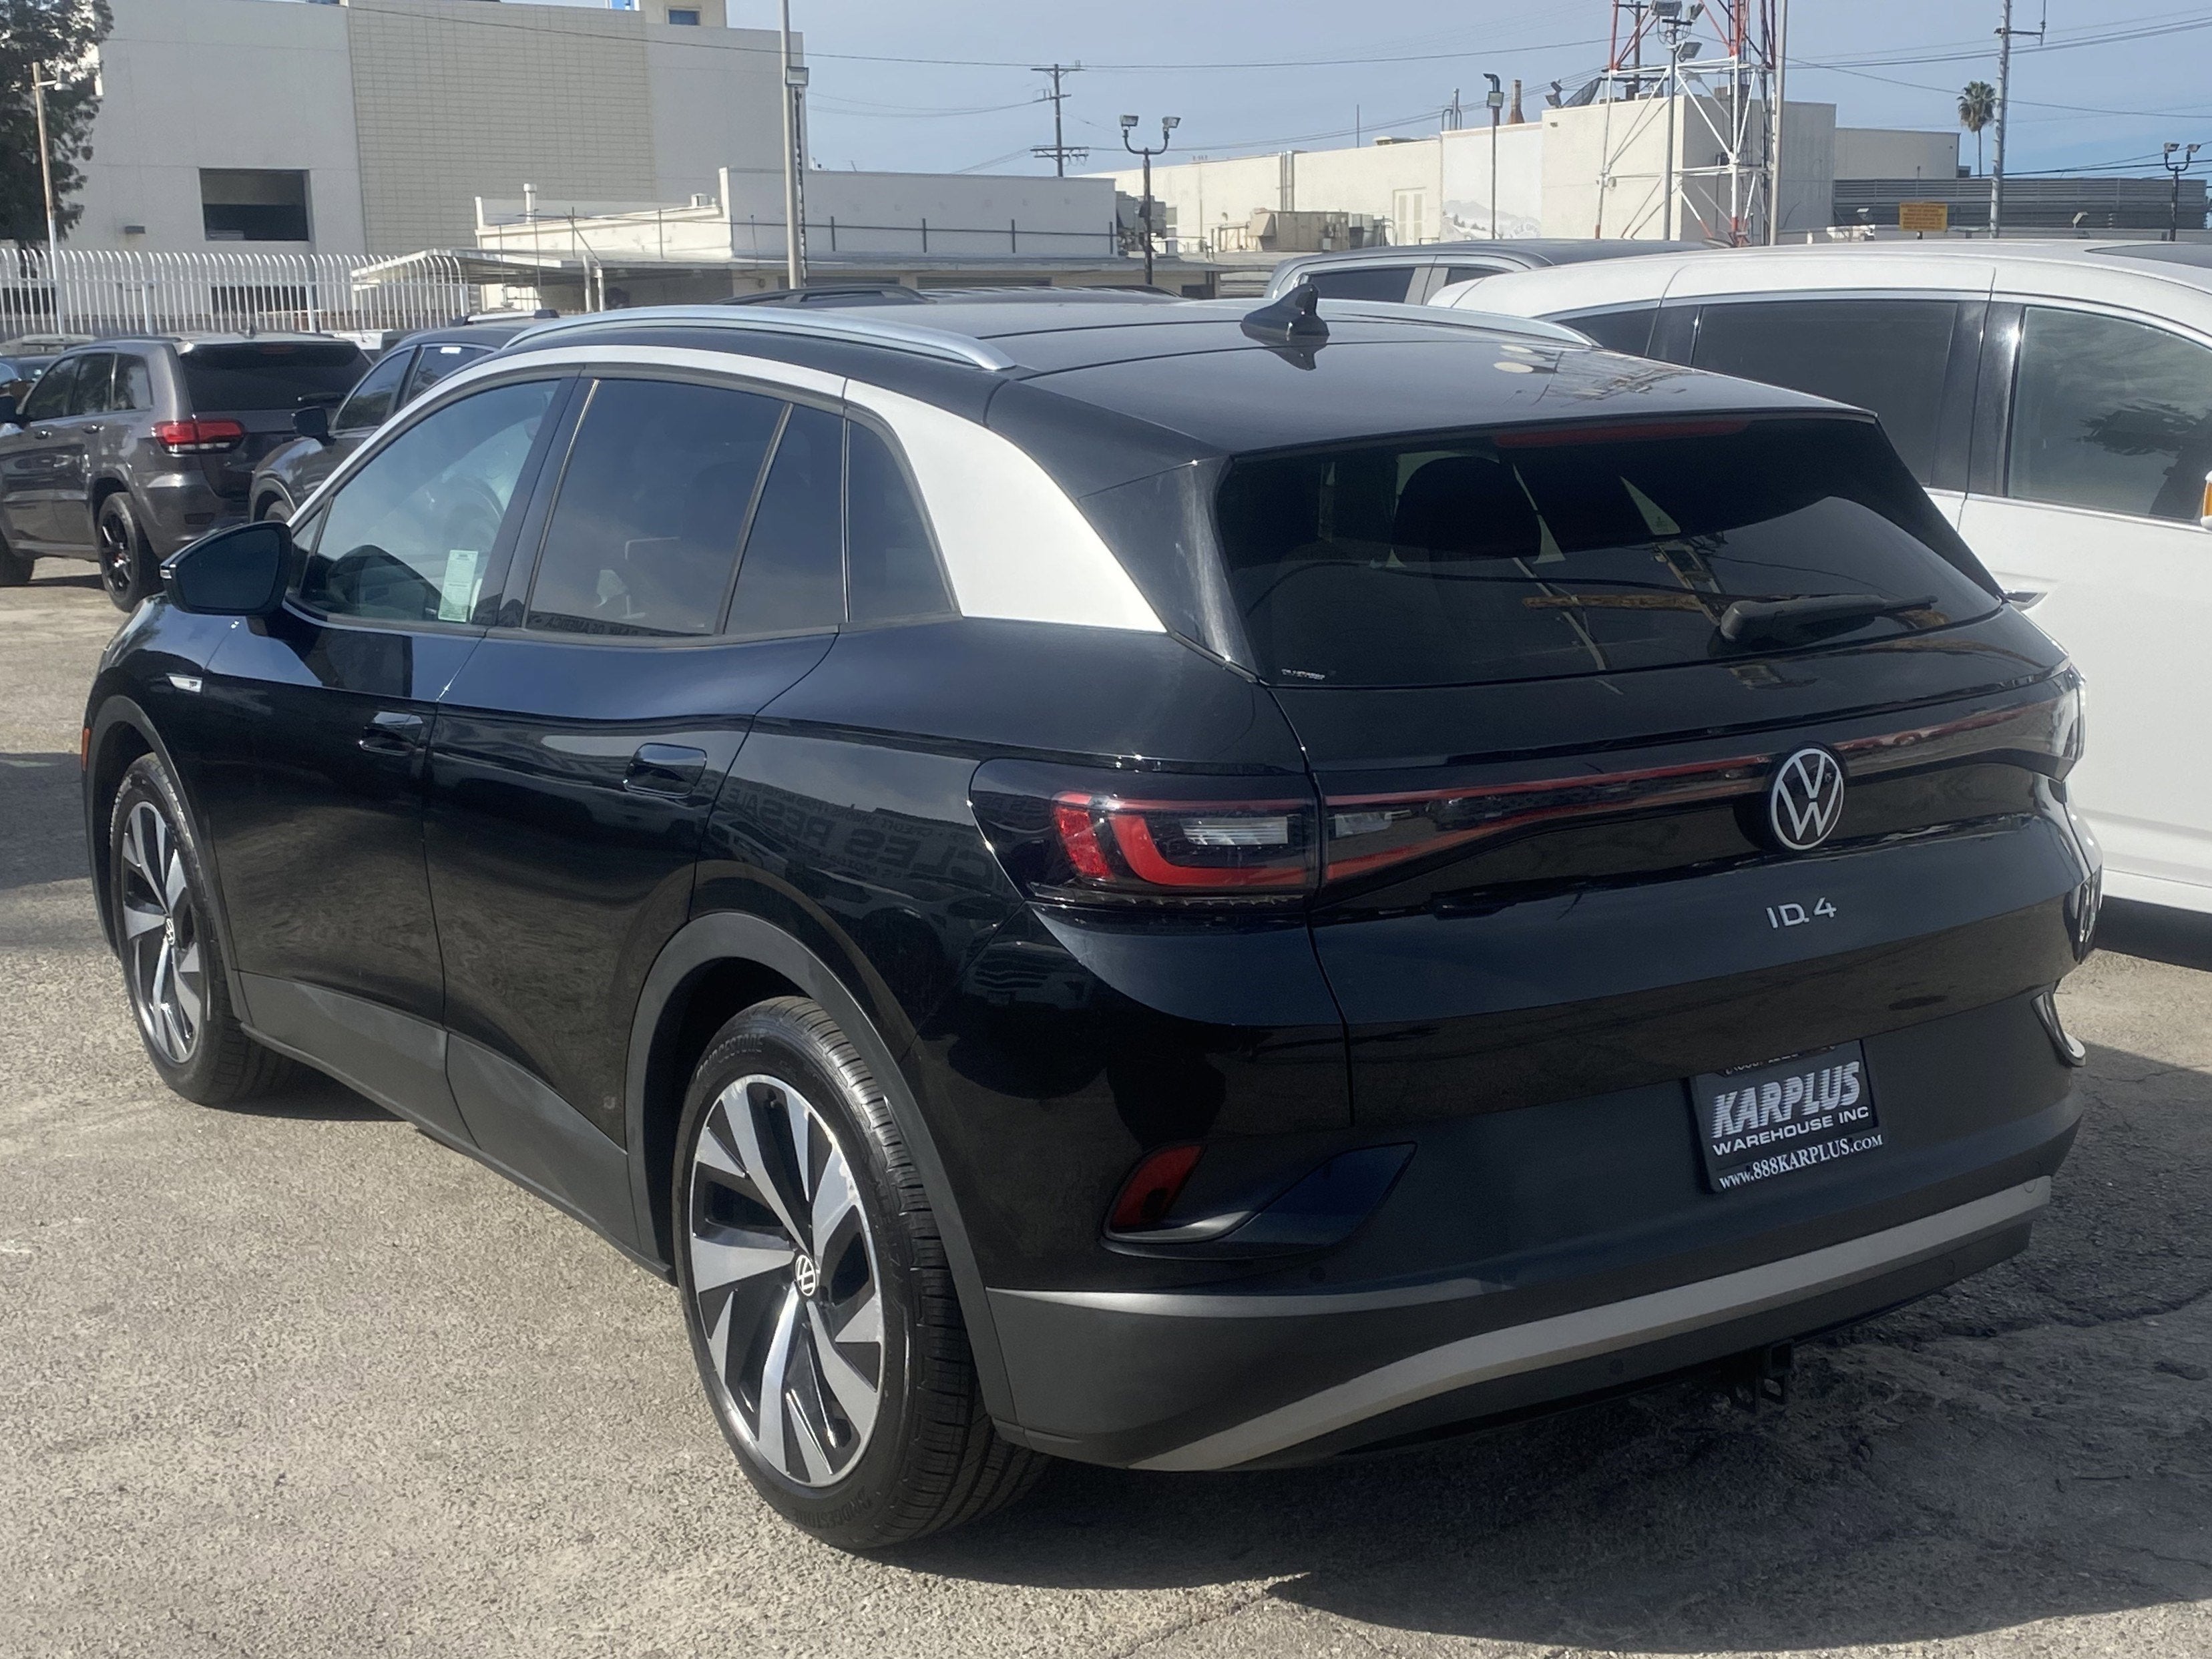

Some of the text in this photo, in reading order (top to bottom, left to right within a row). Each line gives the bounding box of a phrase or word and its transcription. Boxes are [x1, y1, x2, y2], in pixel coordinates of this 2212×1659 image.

[1765, 897, 1837, 929] ID.4
[1711, 1061, 1860, 1139] KARPLUS
[1713, 1106, 1869, 1156] WAREHOUSE INC
